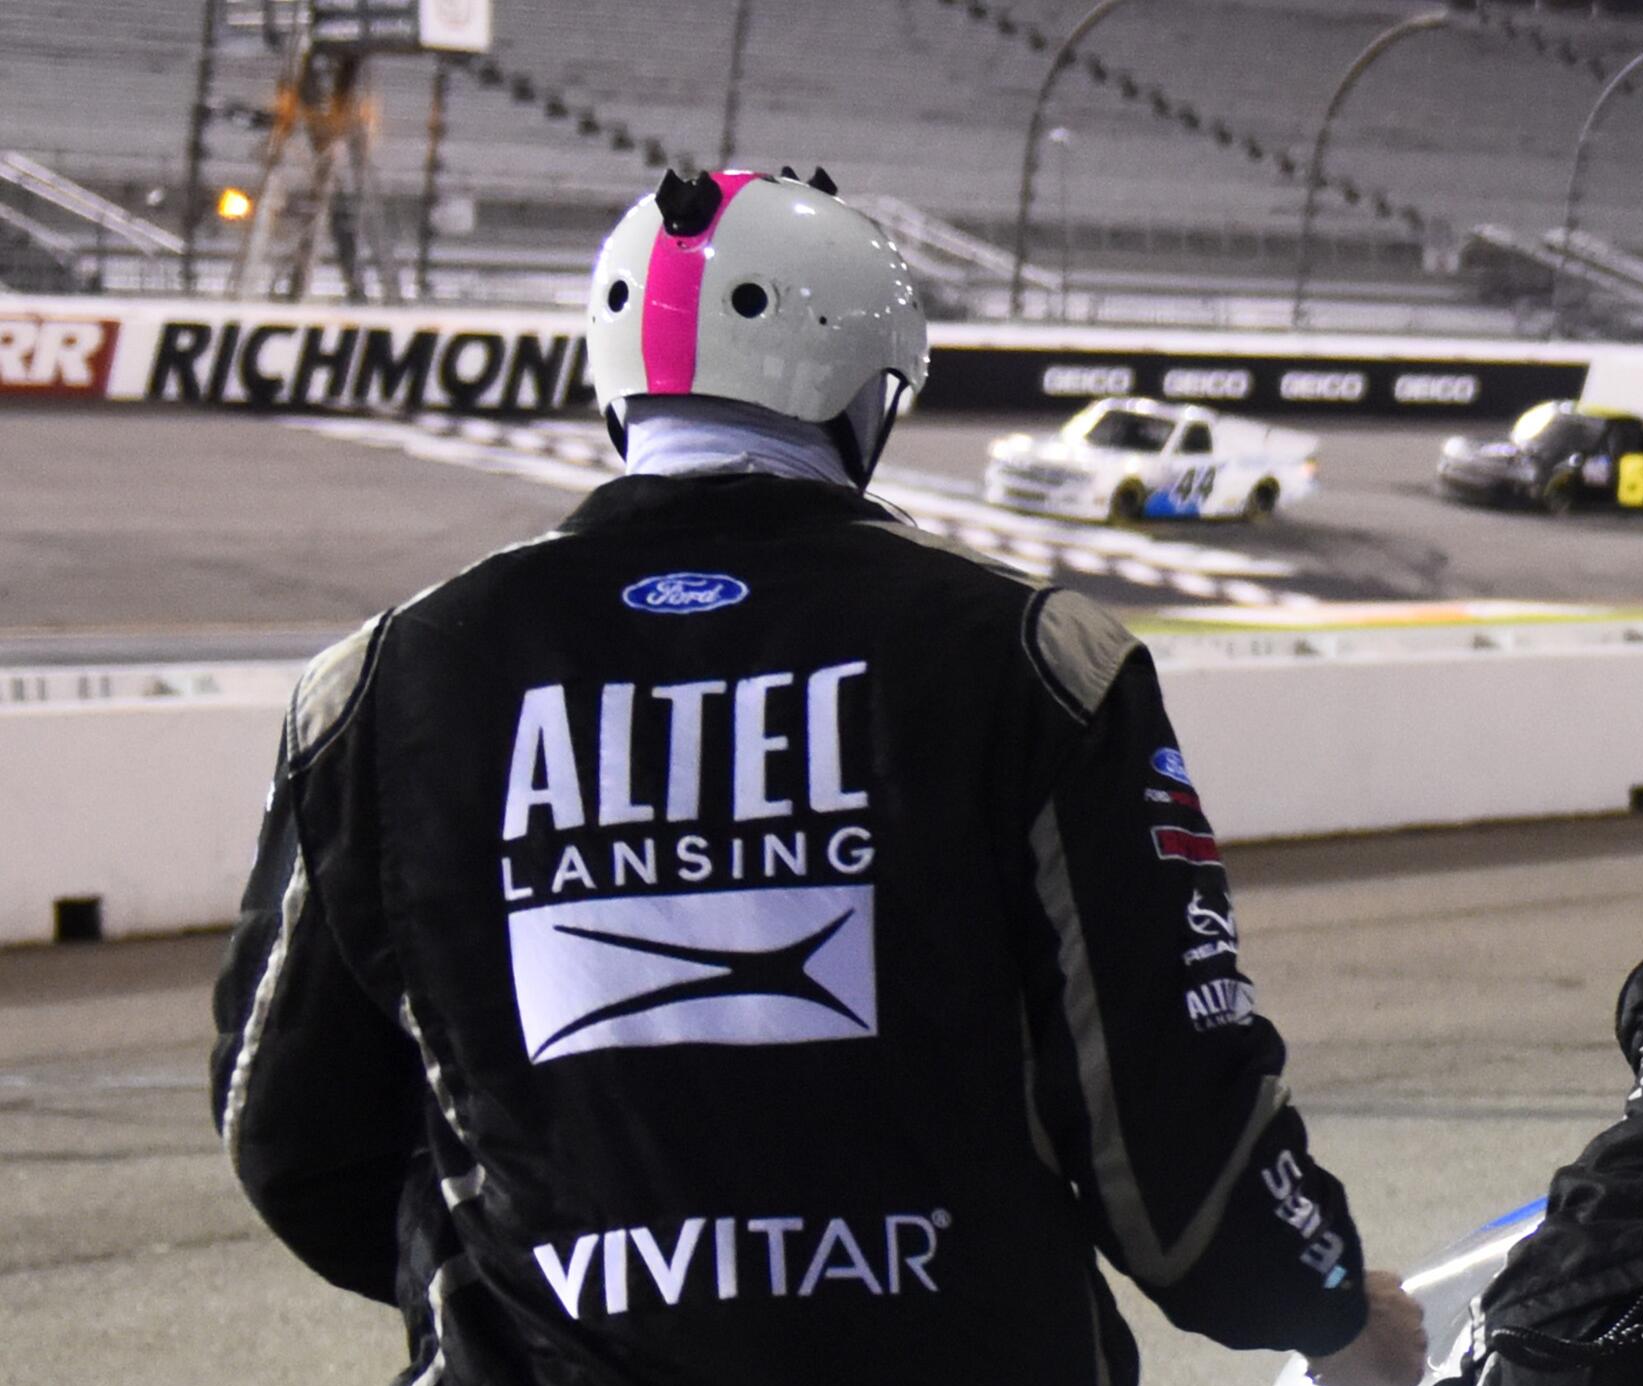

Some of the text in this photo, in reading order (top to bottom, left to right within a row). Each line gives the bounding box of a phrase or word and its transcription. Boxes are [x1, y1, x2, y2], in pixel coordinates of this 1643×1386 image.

[1043, 366, 1134, 396] GEICO
[1163, 369, 1251, 398] GEICO
[1280, 371, 1366, 399] GEICO
[1395, 374, 1478, 403] GEICO
[502, 660, 869, 842] ALTEC
[501, 826, 876, 902] LANSING
[532, 1213, 940, 1320] VIVITAR
